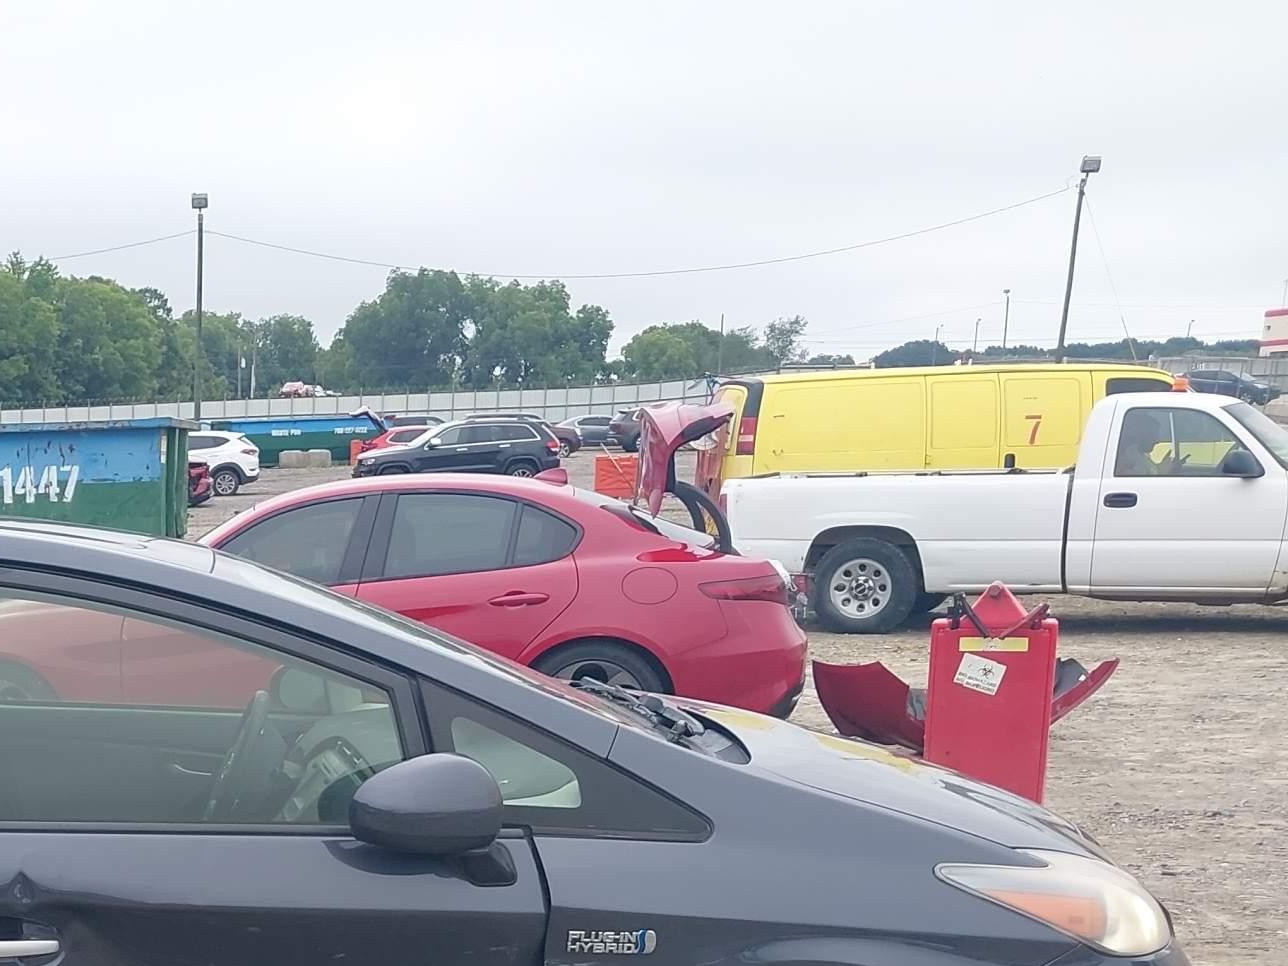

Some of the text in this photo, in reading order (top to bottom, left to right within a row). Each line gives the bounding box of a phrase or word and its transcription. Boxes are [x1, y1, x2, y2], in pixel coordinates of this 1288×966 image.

[1024, 415, 1042, 445] 7
[568, 930, 637, 943] PLUG-IN
[567, 942, 635, 954] HYBRID
